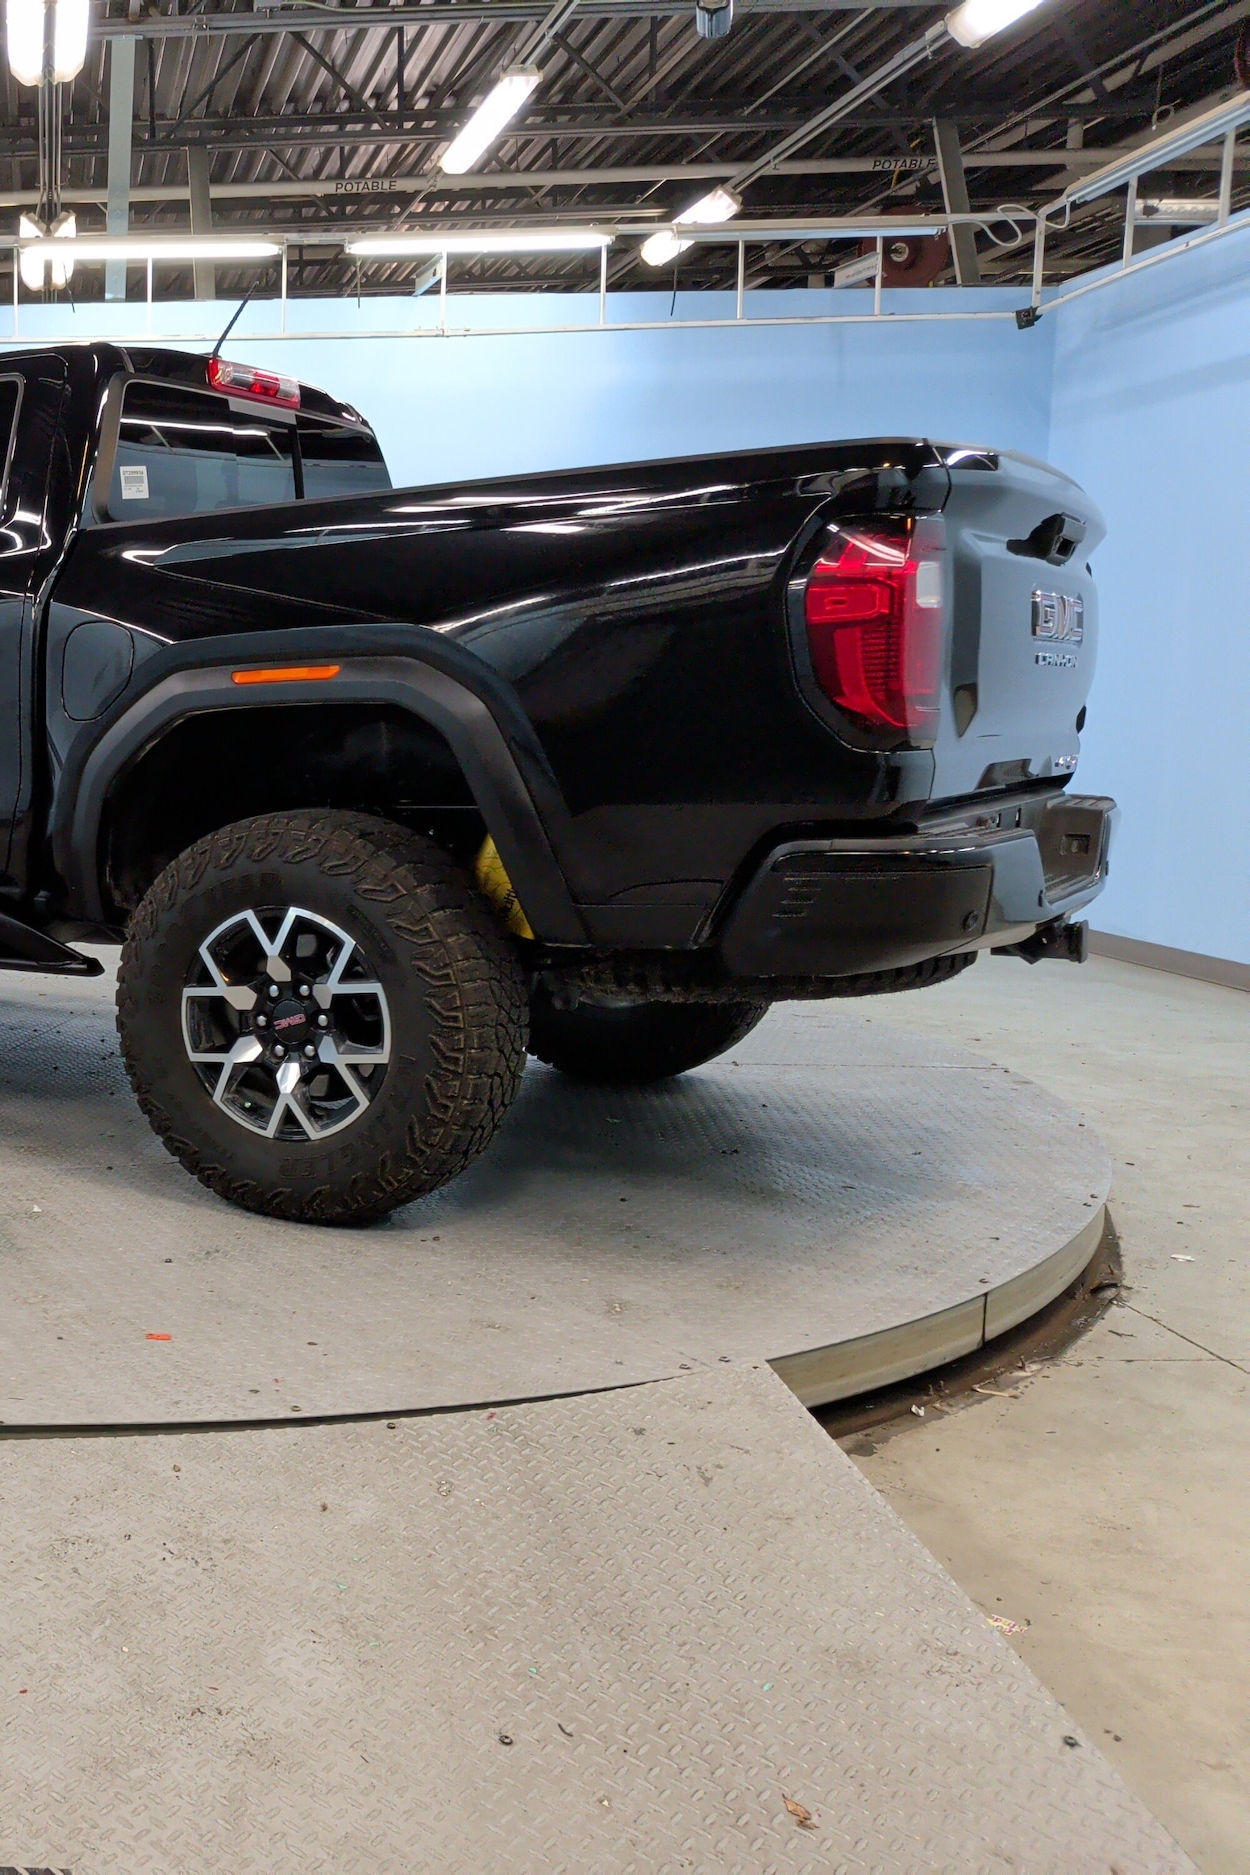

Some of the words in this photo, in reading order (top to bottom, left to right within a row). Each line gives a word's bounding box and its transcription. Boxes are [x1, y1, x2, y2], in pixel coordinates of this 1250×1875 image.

[872, 158, 936, 170] POTABLE
[335, 180, 398, 193] POTABLE
[1031, 590, 1084, 642] GMC
[1035, 651, 1078, 668] CANYON
[273, 1013, 307, 1031] GMC
